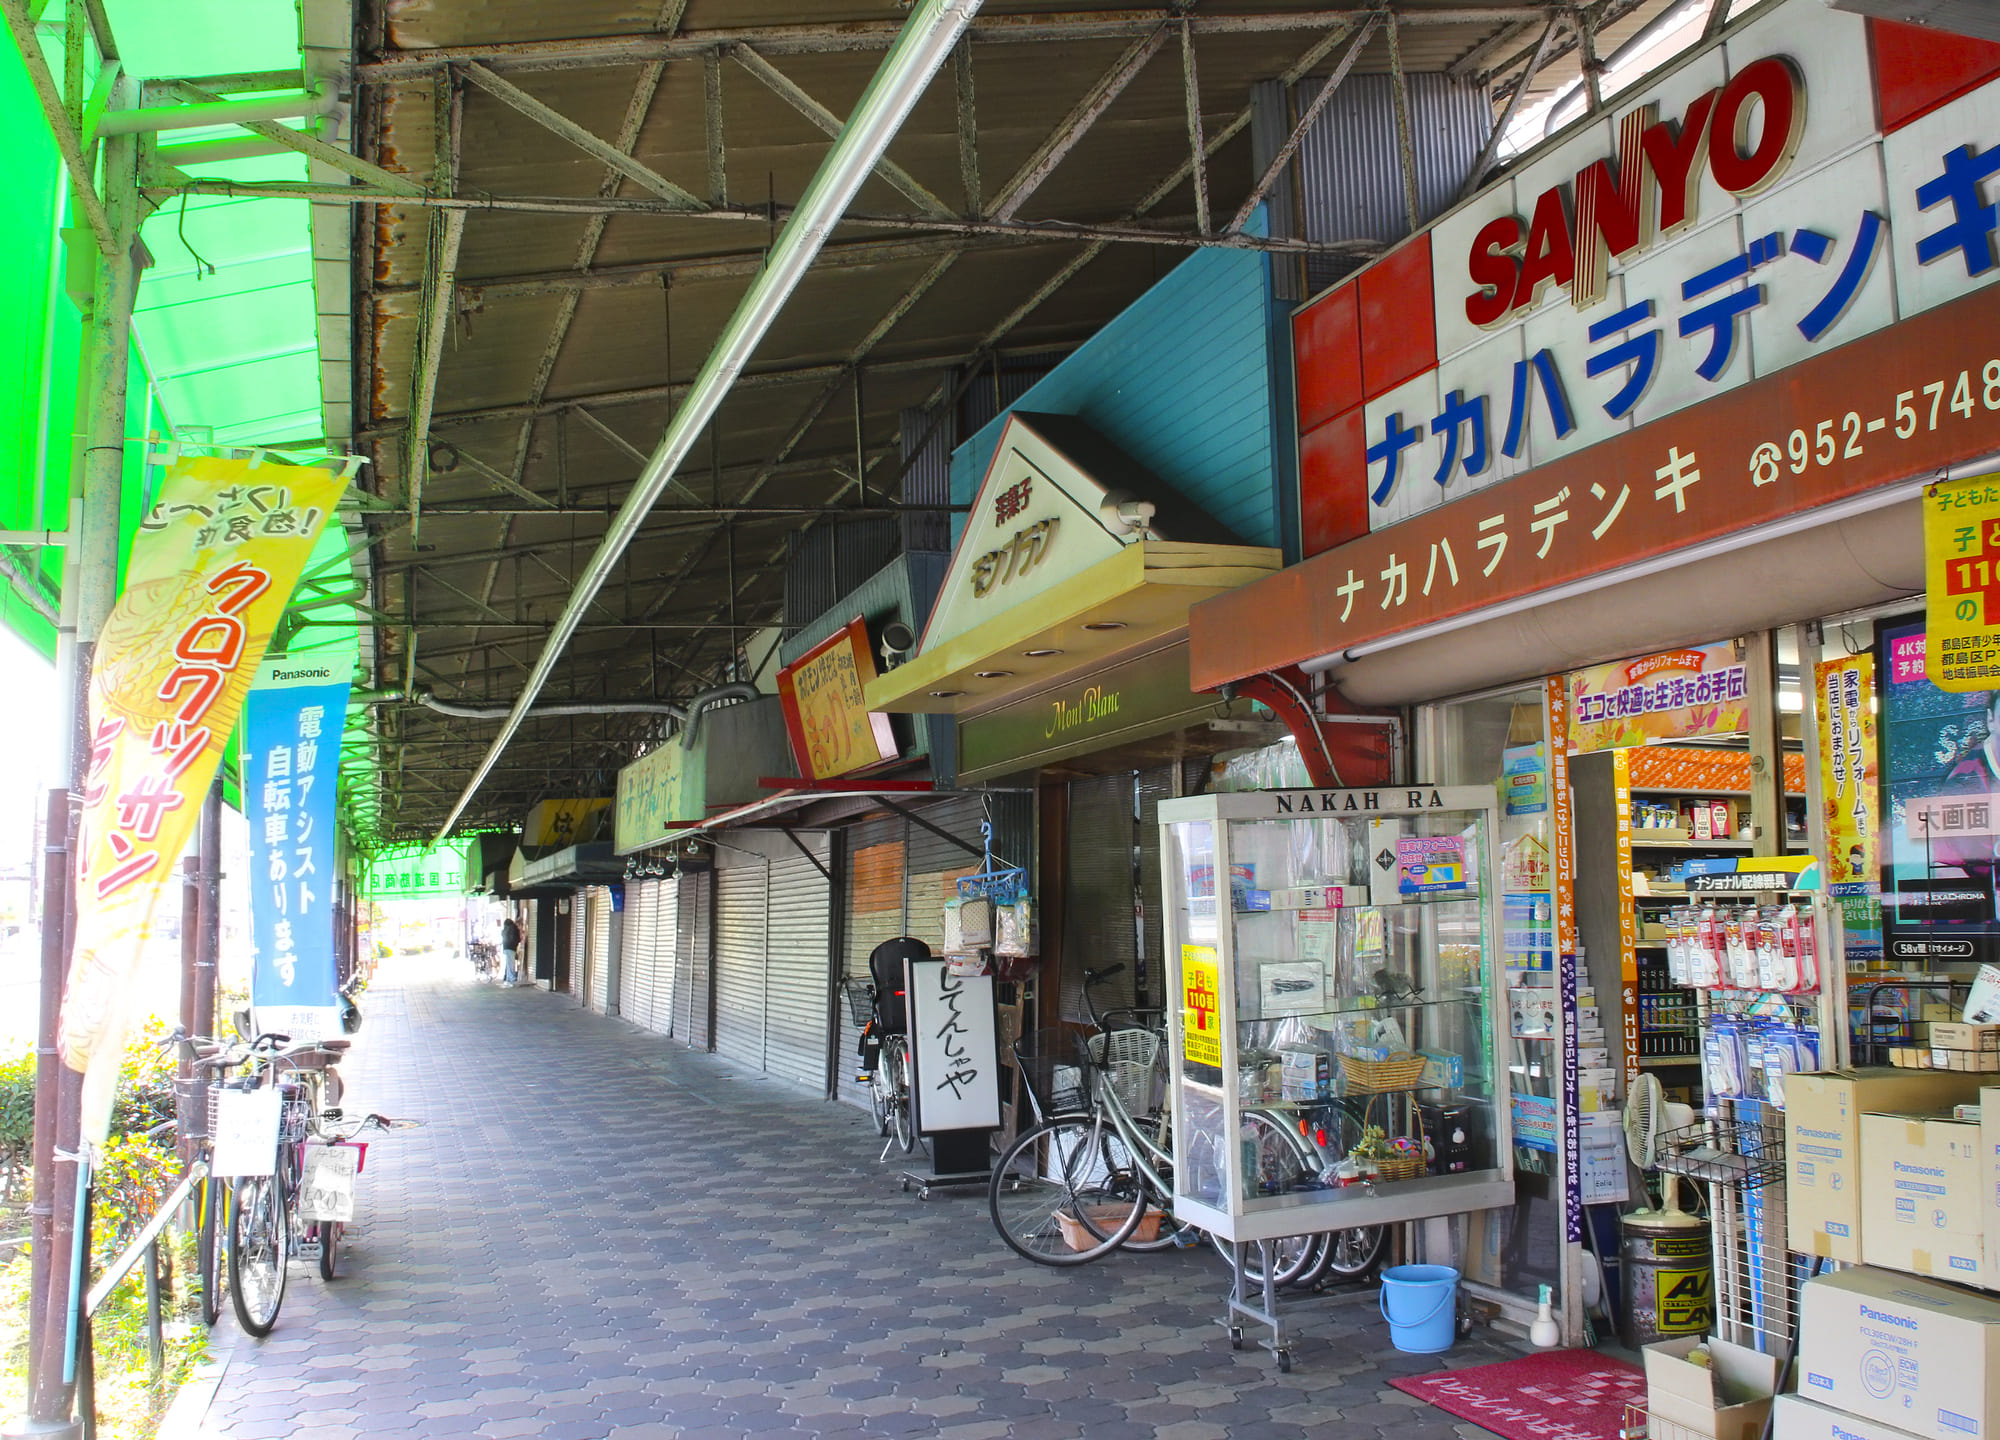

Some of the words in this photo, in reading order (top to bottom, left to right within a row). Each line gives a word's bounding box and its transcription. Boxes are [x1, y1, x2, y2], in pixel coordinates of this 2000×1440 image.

[1466, 54, 1806, 330] SANYO
[1367, 144, 2000, 508] ナカハラデンキ
[1787, 358, 2000, 474] 952-5748
[996, 476, 1032, 528] 洋菓子
[1337, 446, 1701, 622] ナカハラデンキ
[971, 515, 1060, 599] モンブラン
[1956, 599, 1977, 622] の
[272, 667, 330, 680] Panasonic
[1629, 654, 1700, 680] 家電からリフォームまで
[1898, 659, 1925, 677] 予約
[1942, 650, 2000, 666] 都島区P
[98, 561, 272, 899] クロワッサン
[1045, 700, 1082, 738] Mont
[1084, 685, 1120, 722] Blanc
[1843, 670, 1867, 837] 家電からリフォームまで
[296, 706, 325, 915] 電動アシスト
[1277, 792, 1379, 813] NAKAH
[1407, 790, 1443, 808] RA
[1554, 754, 1569, 880] 補聴器もパナソニックで
[263, 745, 298, 988] 自転車あります
[1615, 787, 1634, 964] 補聴器もパナソニックで
[1695, 873, 1787, 890] ナショナル配線器具
[1565, 1010, 1578, 1186] 家電からリフォームまでおまかせ
[1796, 1125, 1842, 1141] Panasonic
[1894, 1161, 1945, 1177] Panasonic
[1860, 1304, 1918, 1330] Panasonic
